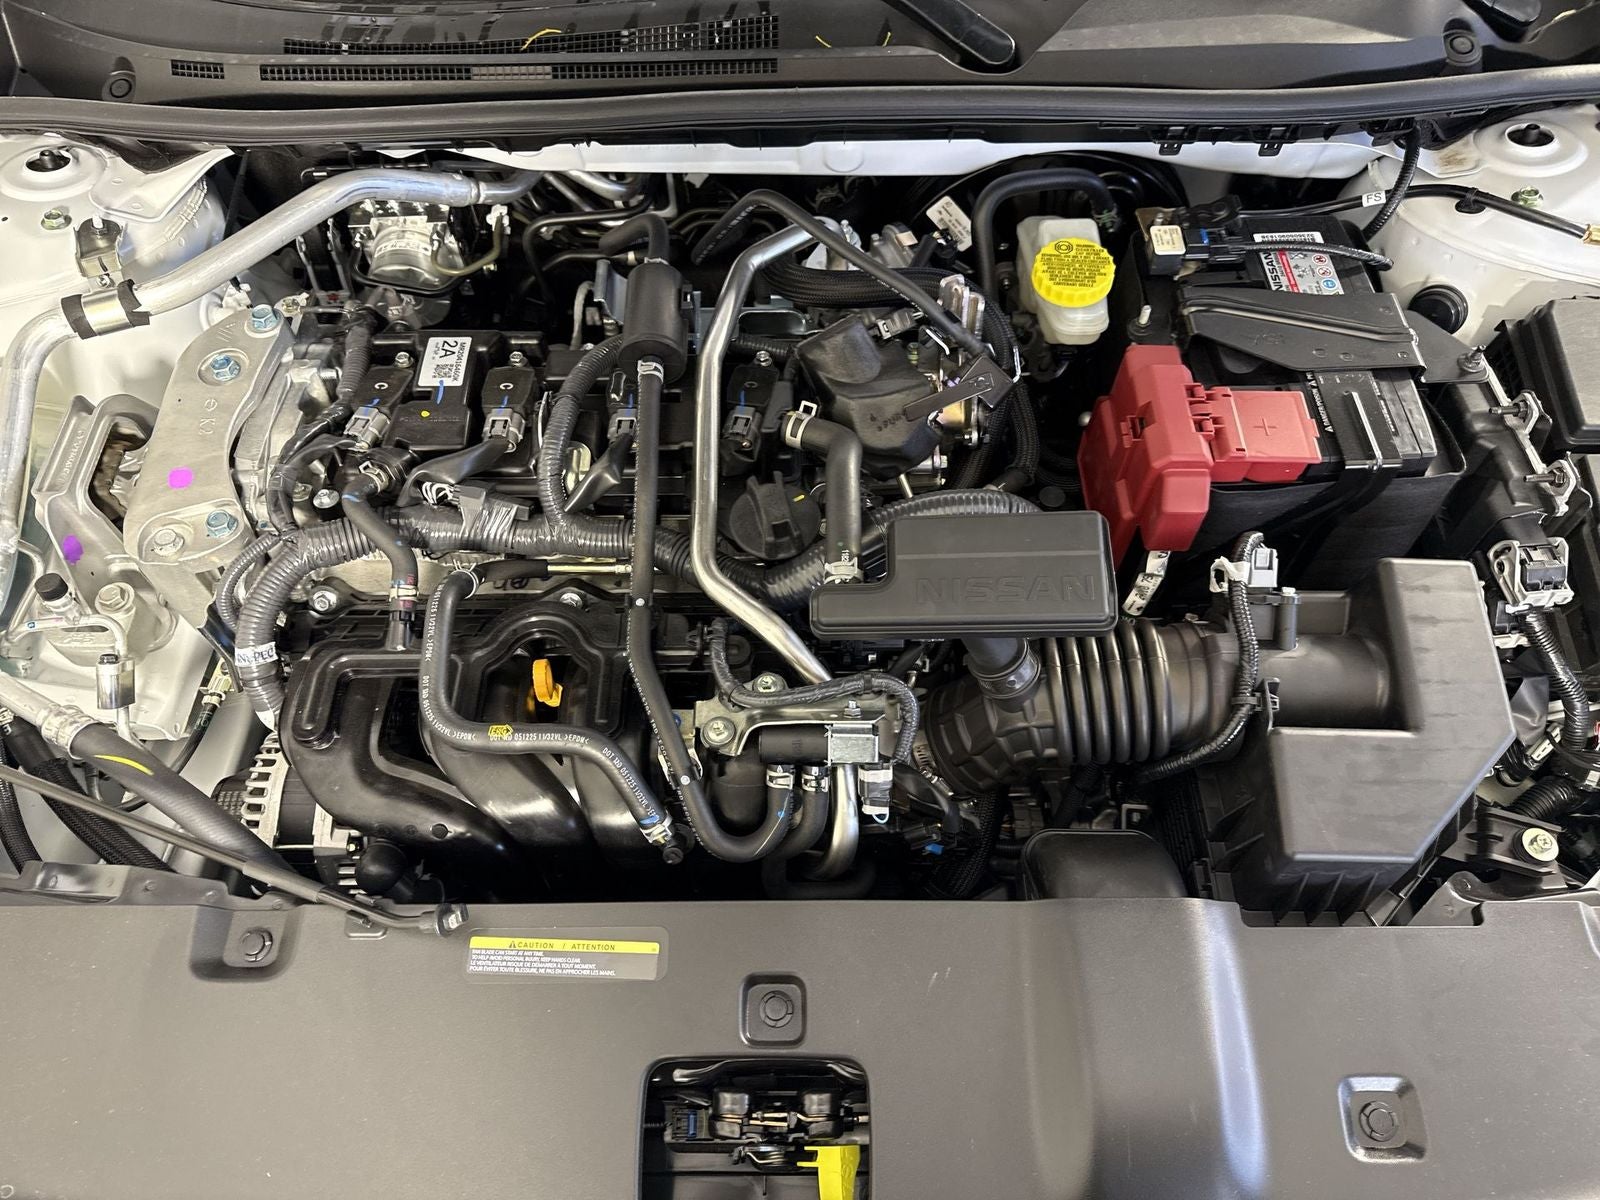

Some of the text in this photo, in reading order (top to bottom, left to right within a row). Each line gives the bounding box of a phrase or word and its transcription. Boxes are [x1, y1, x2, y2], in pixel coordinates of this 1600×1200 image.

[1366, 192, 1382, 204] FS
[1262, 250, 1284, 291] NISSAN
[439, 340, 459, 359] 2A
[915, 575, 1096, 602] NISSAN
[423, 700, 435, 722] 051225
[514, 732, 537, 742] 051225
[620, 767, 637, 788] 051225
[571, 943, 616, 951] ATTENTION
